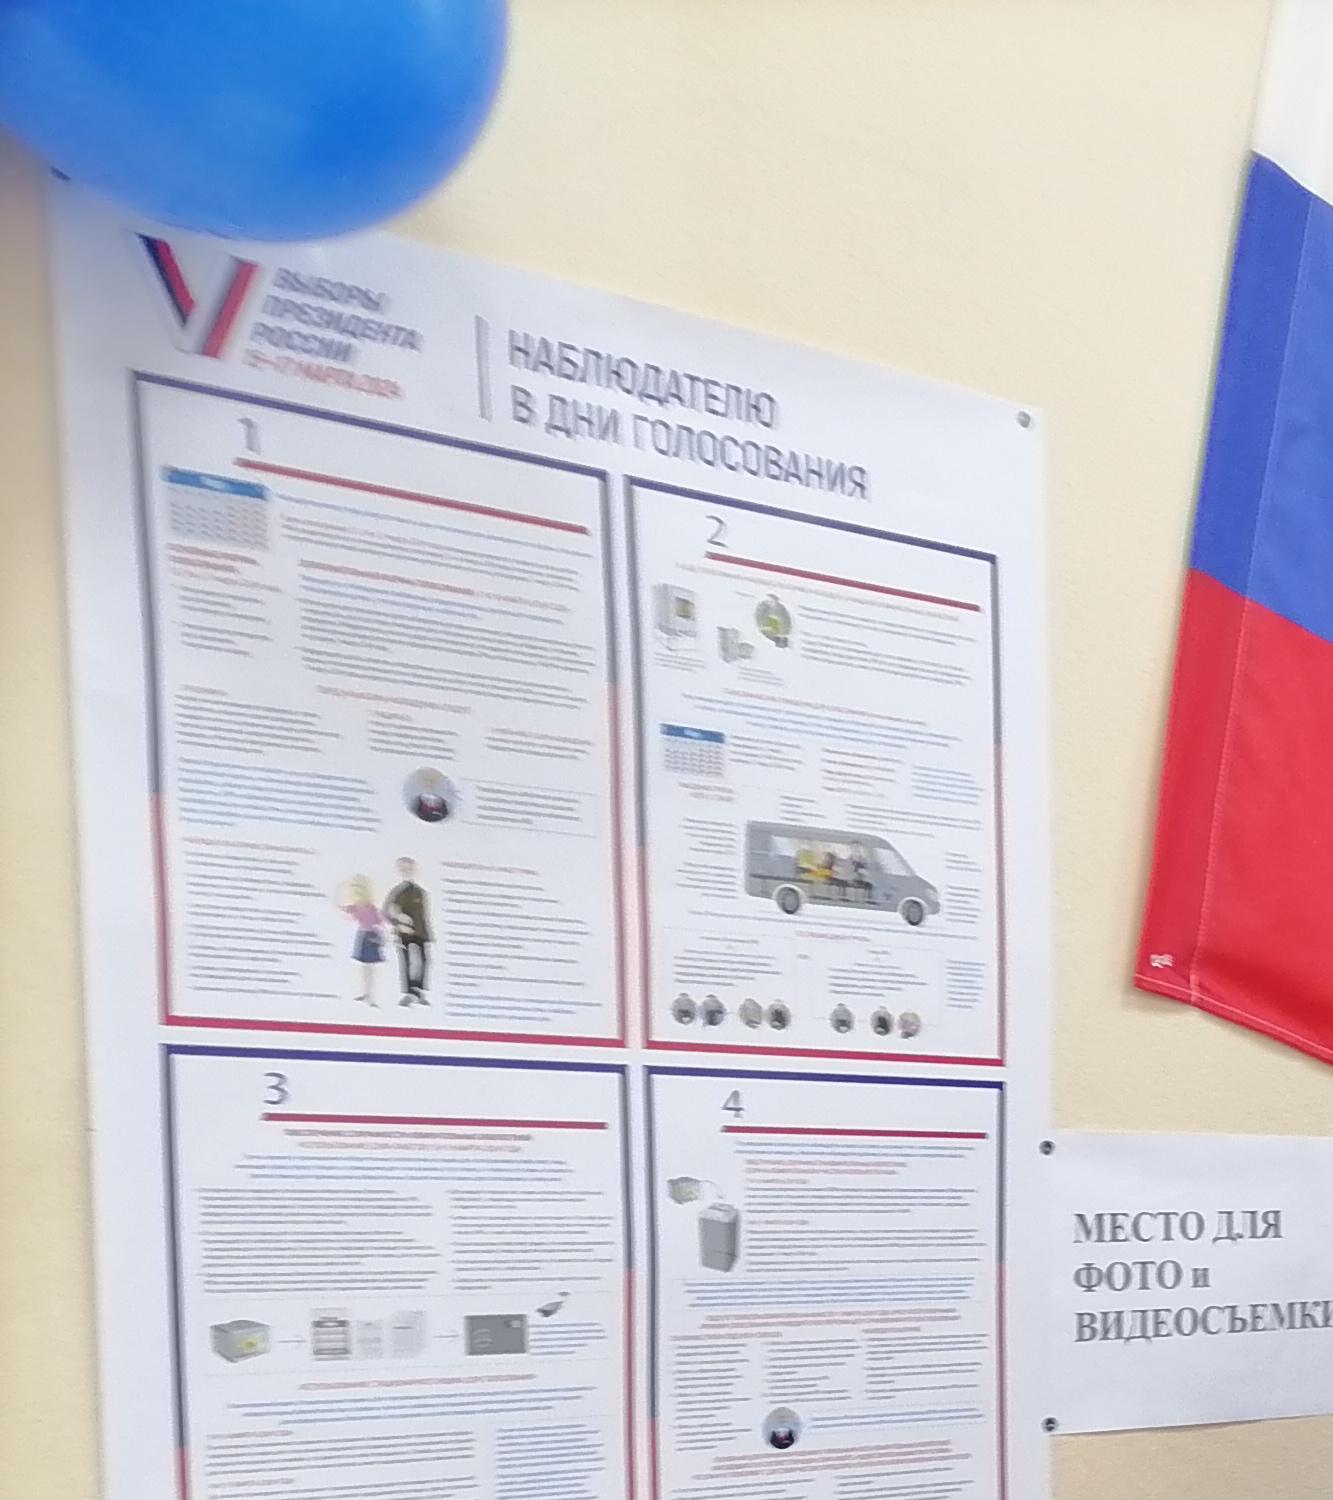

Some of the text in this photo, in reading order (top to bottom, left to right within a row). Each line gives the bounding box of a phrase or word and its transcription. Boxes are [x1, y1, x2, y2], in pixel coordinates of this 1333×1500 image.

[508, 329, 779, 429] НАБЛЮДАТЕЛЮ
[237, 416, 262, 455] 1
[510, 384, 872, 502] В ДНИ ГОЛОСОВАНИЯ
[704, 514, 729, 549] 2
[262, 1071, 290, 1106] 3
[721, 1089, 745, 1119] 4
[1072, 1209, 1283, 1246] МЕСТО ДЛЯ
[1072, 1260, 1212, 1292] ФОТО и
